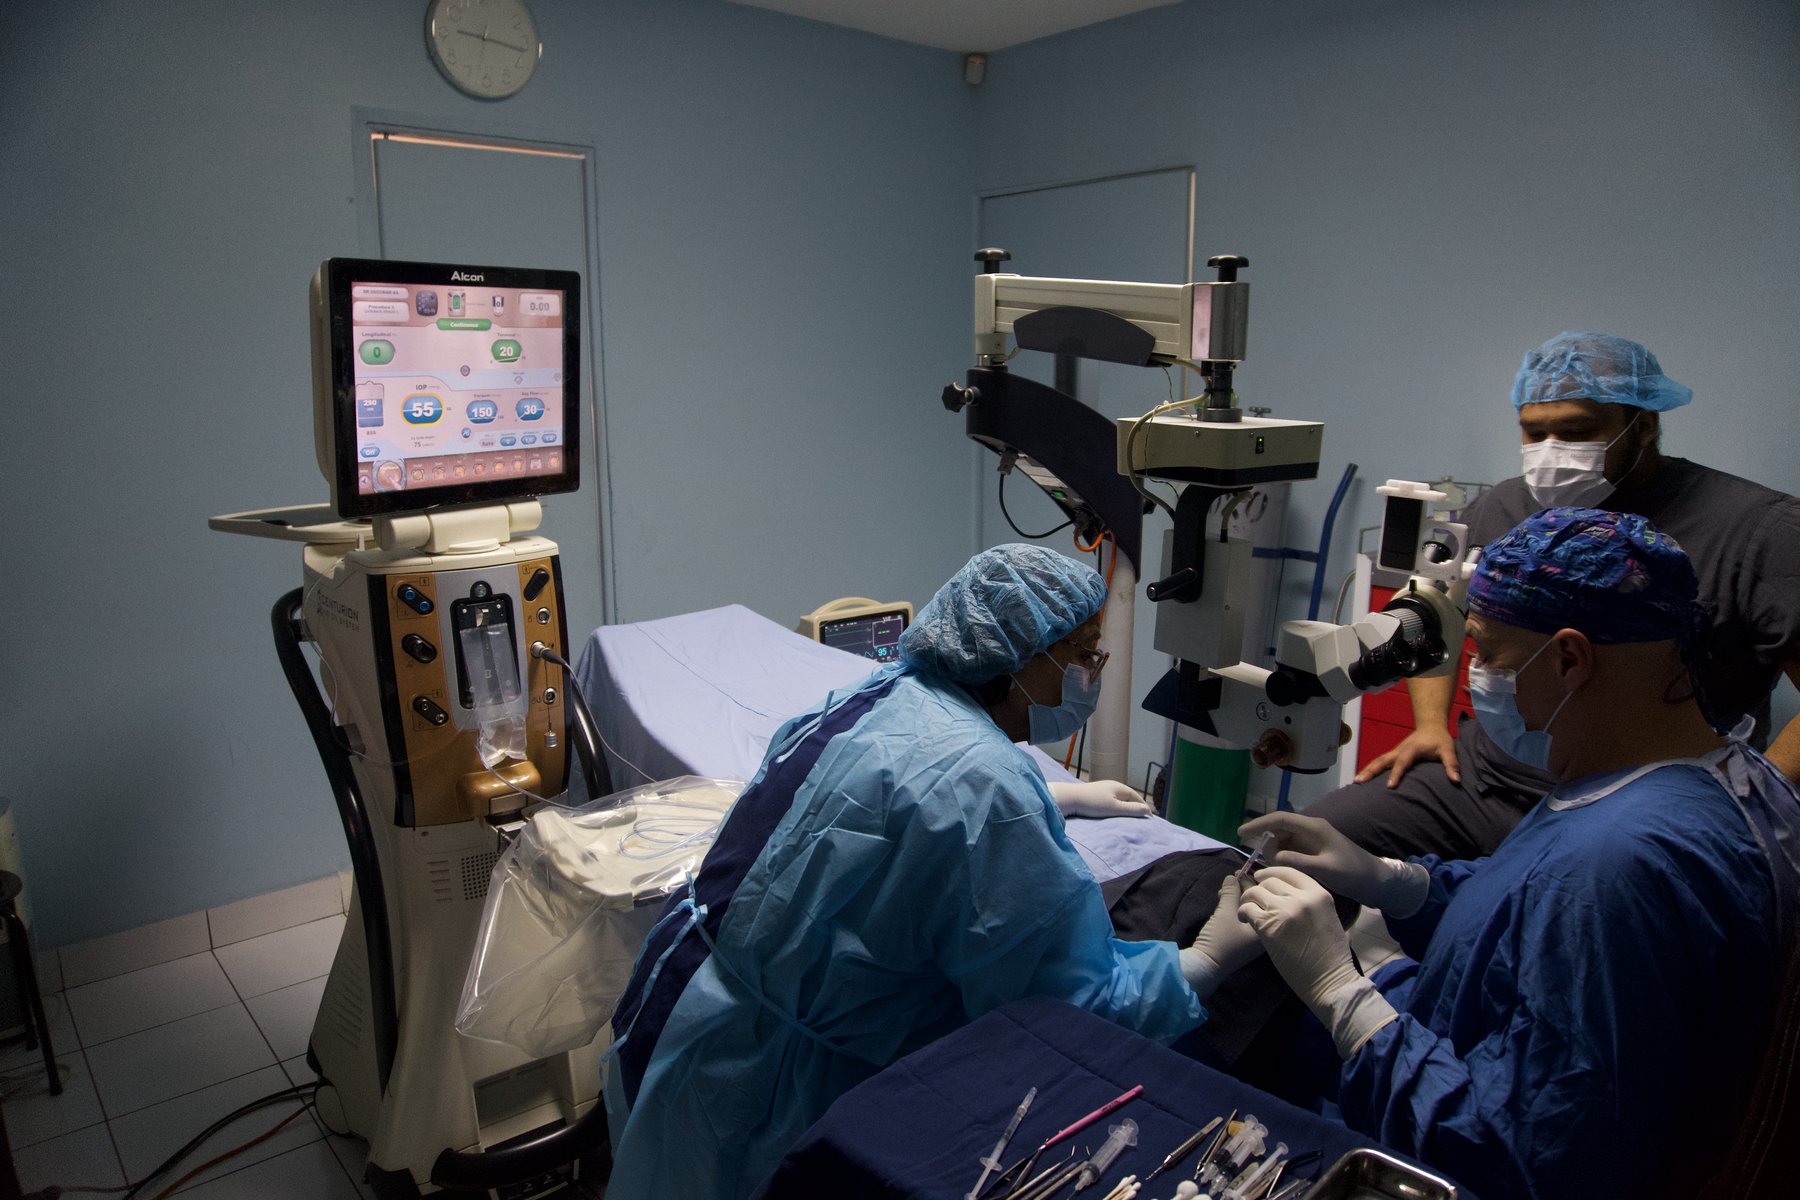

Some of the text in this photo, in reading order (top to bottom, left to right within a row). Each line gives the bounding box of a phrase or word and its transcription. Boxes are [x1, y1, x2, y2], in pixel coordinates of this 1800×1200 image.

[451, 271, 484, 282] Alcon
[530, 302, 550, 311] 0.00
[373, 347, 381, 358] 0
[500, 346, 513, 356] 20
[412, 402, 434, 417] 55
[472, 407, 493, 418] 150
[524, 405, 537, 414] 30
[877, 647, 887, 656] 95
